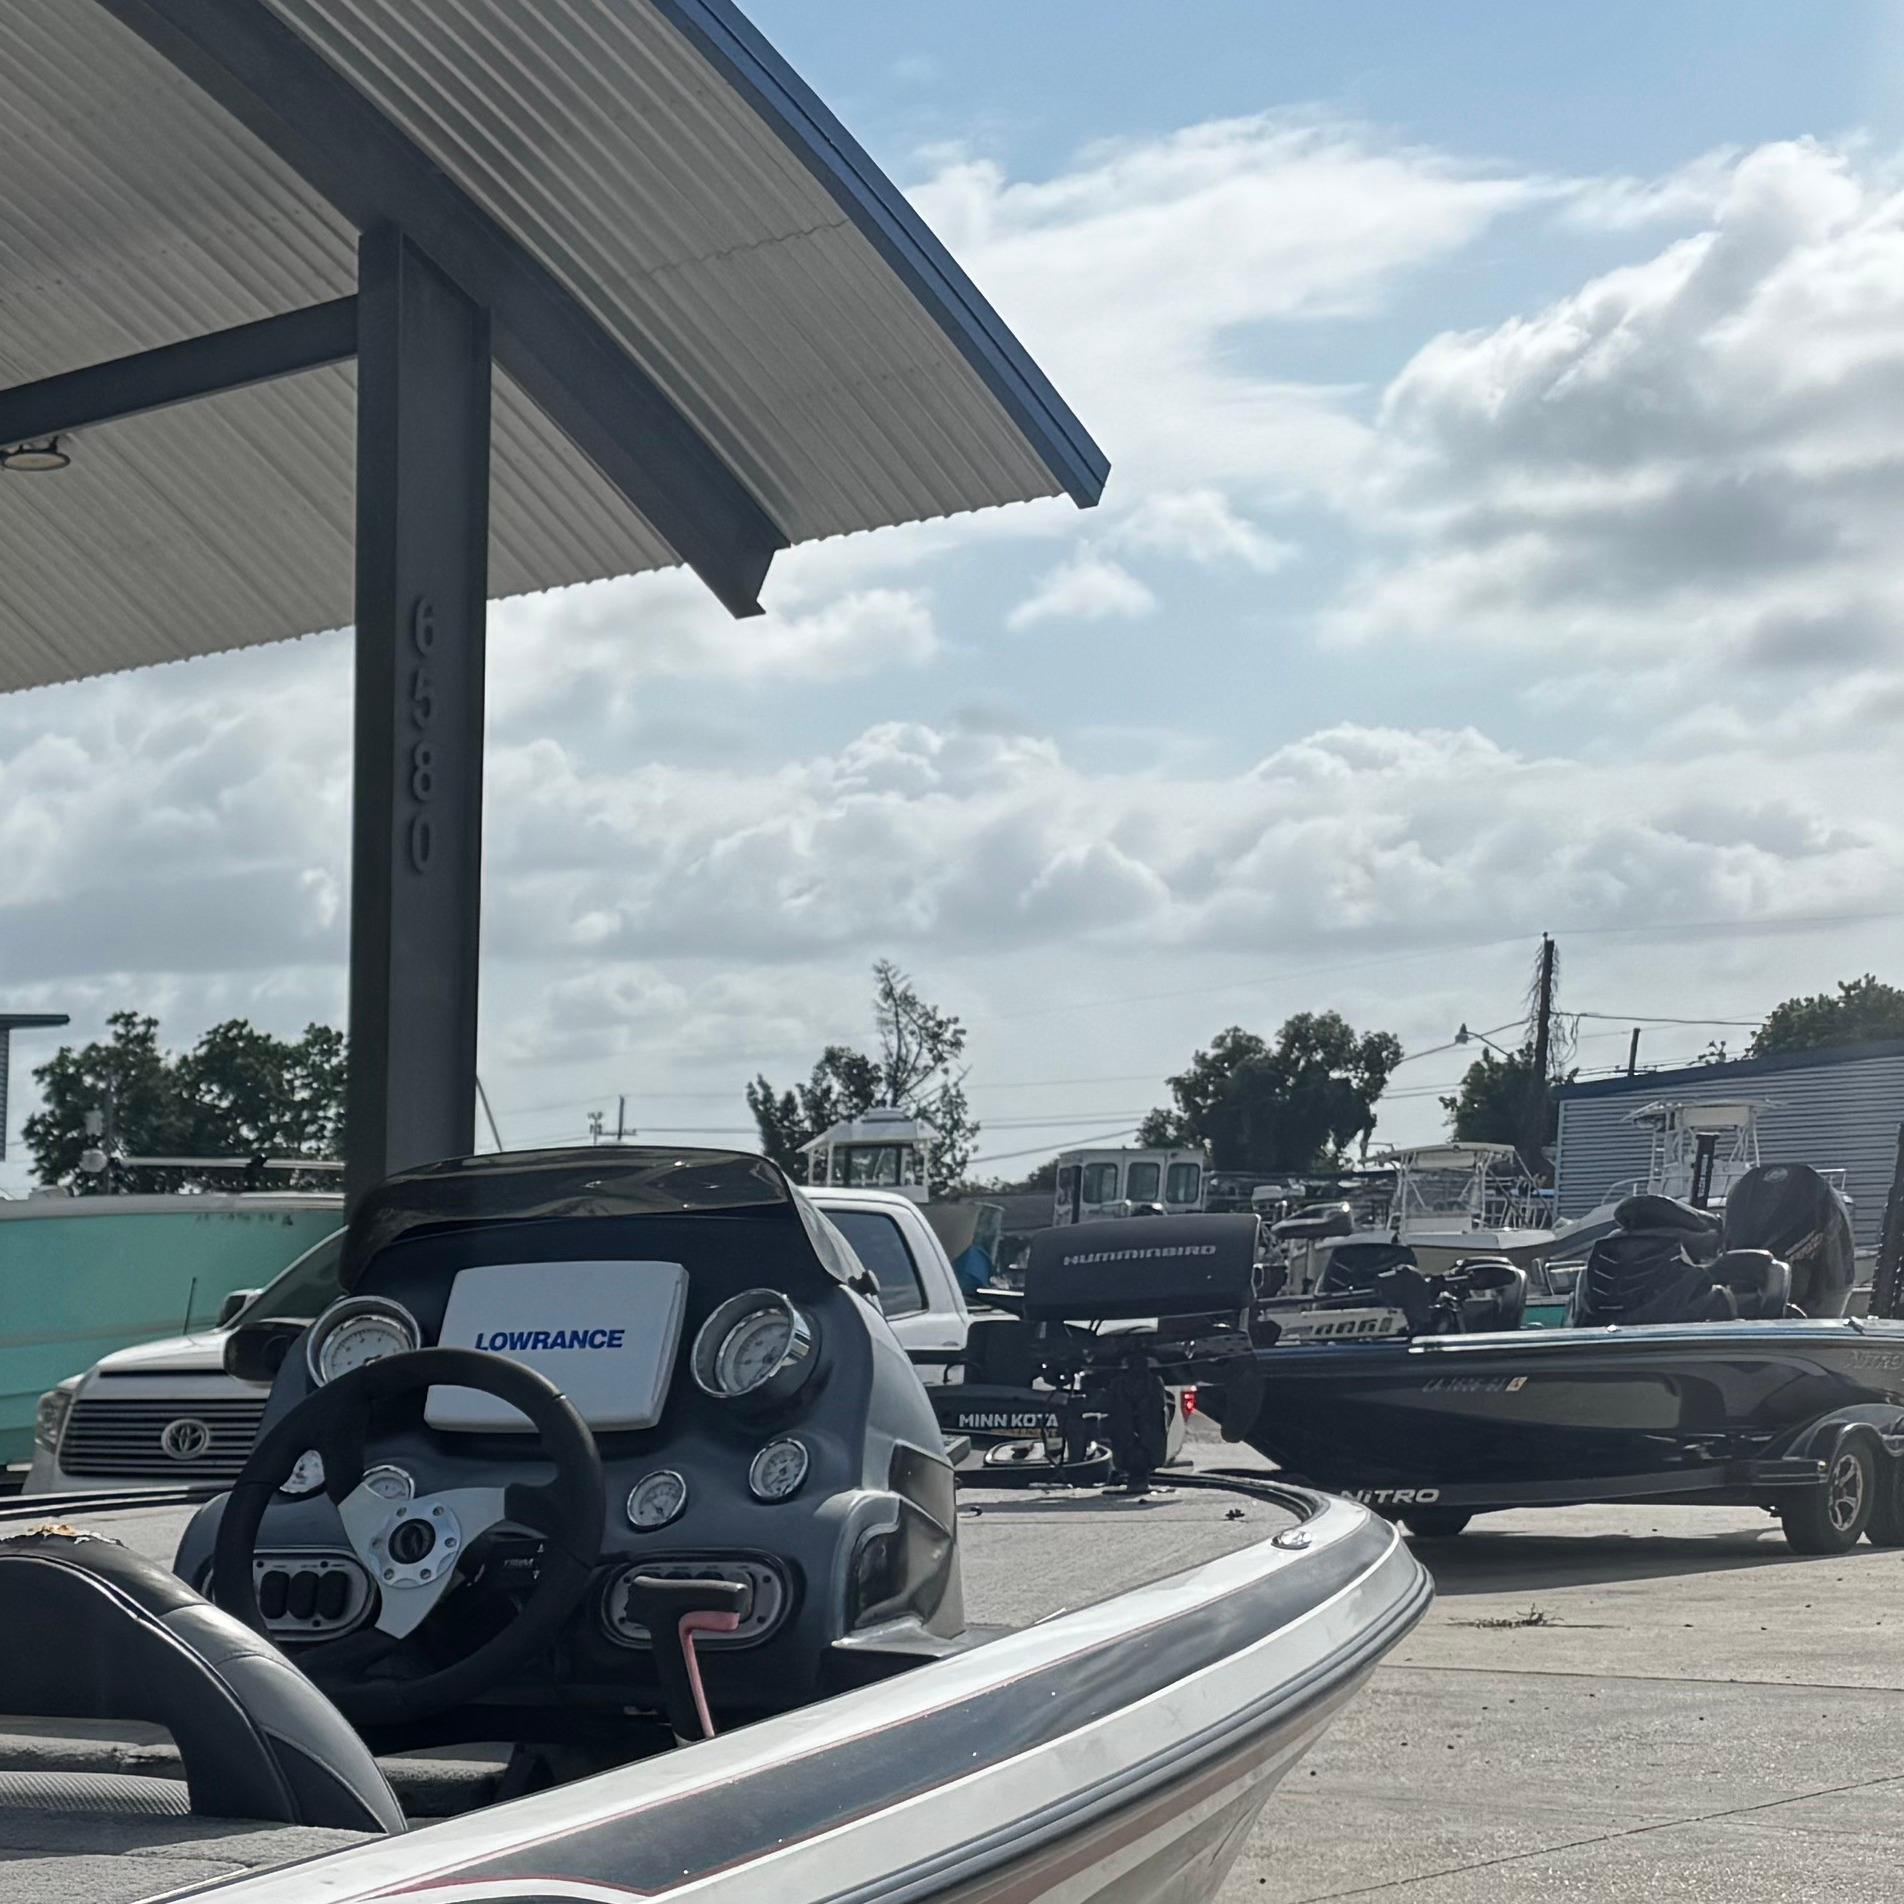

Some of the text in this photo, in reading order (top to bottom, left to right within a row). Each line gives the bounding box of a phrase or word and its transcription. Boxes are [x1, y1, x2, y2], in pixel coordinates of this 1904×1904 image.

[410, 597, 437, 876] 6580
[1063, 1245, 1217, 1266] HUMMINBIRD
[475, 1329, 625, 1351] LOWRANCE
[958, 1413, 1008, 1428] MINN
